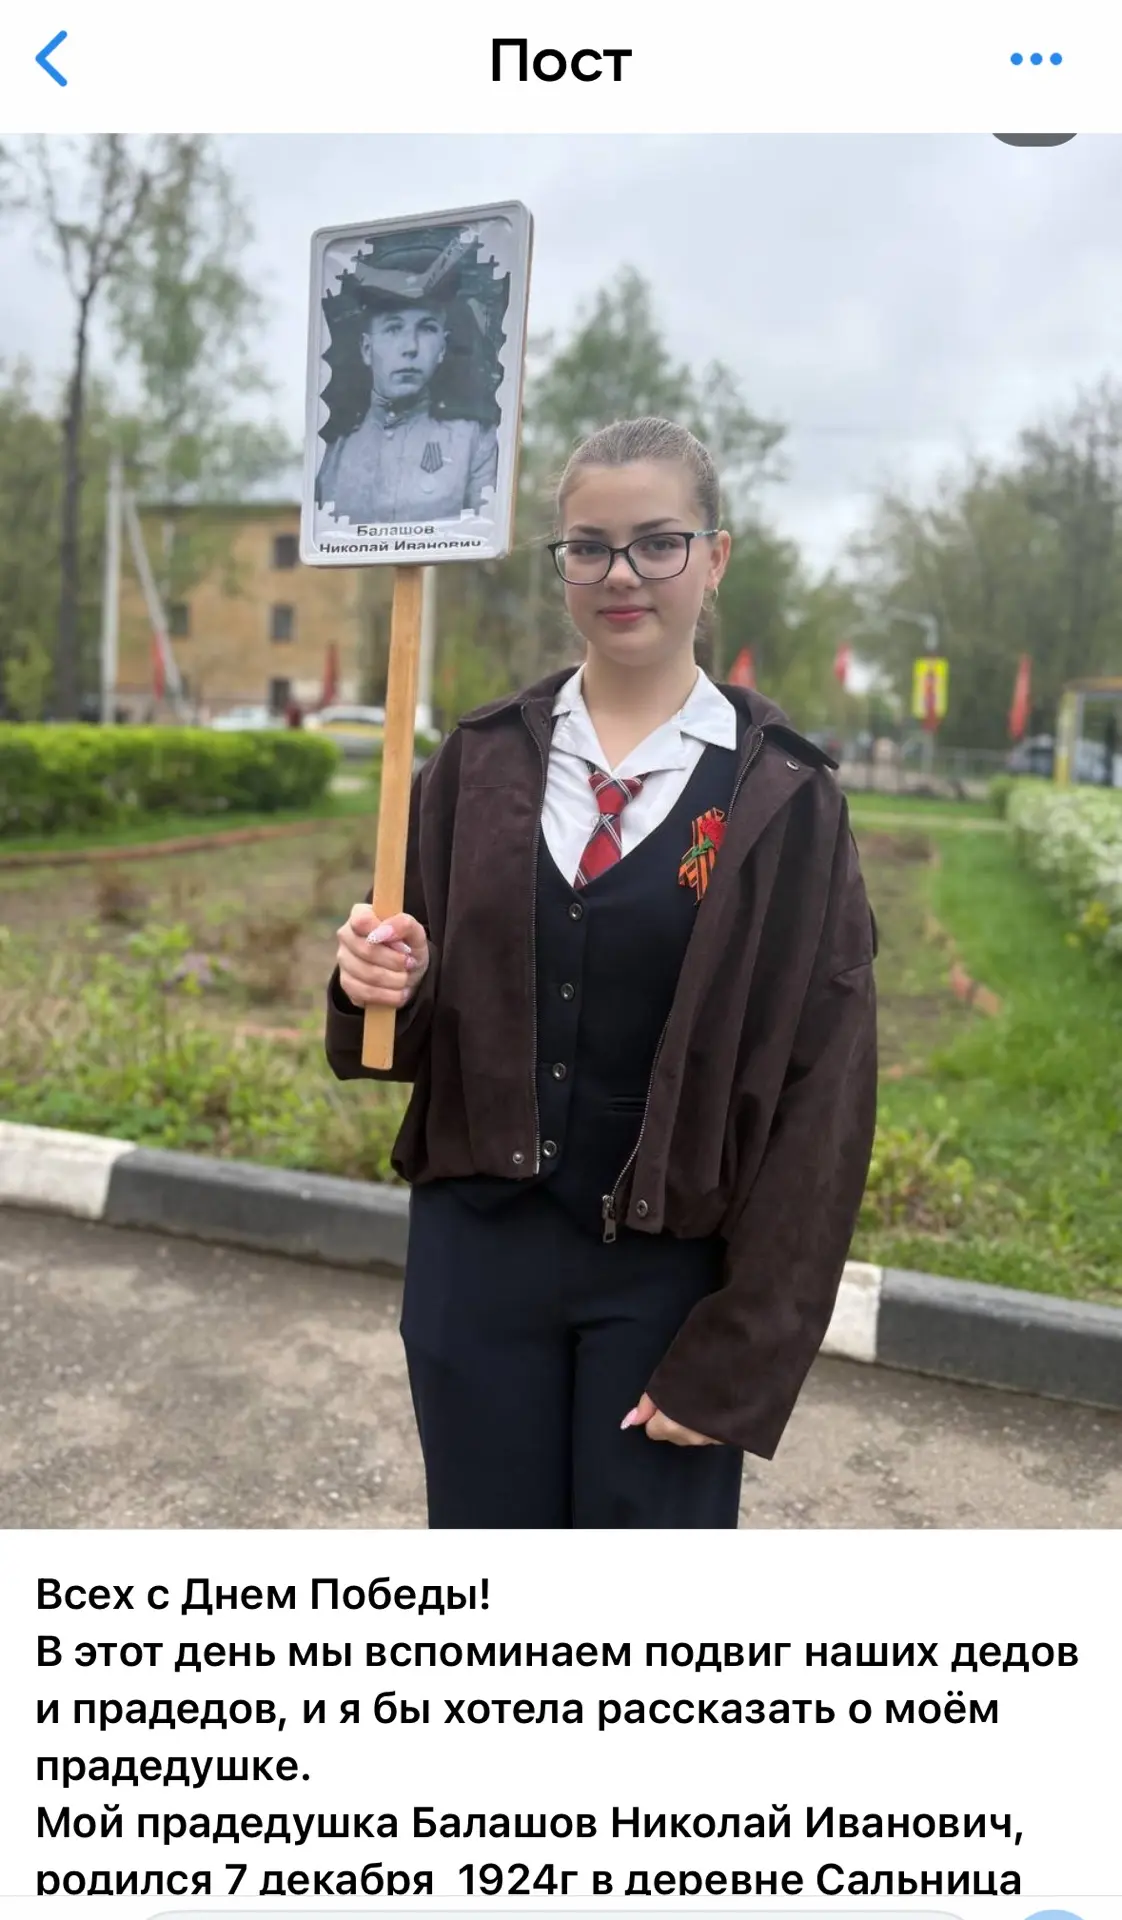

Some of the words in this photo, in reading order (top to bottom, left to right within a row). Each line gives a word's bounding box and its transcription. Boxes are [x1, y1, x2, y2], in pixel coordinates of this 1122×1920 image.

[492, 38, 633, 83] Пост
[319, 541, 389, 553] Николай
[356, 525, 435, 537] Балашов
[37, 1577, 135, 1610] Всех
[147, 1585, 169, 1610] с
[181, 1577, 296, 1616] Днем
[311, 1576, 489, 1616] Победы!
[37, 1635, 62, 1667] В
[74, 1642, 164, 1667] этот
[174, 1642, 276, 1673] день
[289, 1642, 352, 1667] мы
[366, 1642, 631, 1667] вспоминаем
[646, 1642, 792, 1673] подвиг
[805, 1642, 939, 1667] наших
[951, 1642, 1079, 1673] дедов
[37, 1699, 59, 1724] и
[74, 1699, 287, 1732] прадедов,
[303, 1699, 326, 1724] и
[339, 1699, 360, 1724] я
[373, 1690, 430, 1724] бы
[443, 1699, 583, 1724] хотела
[598, 1699, 836, 1732] рассказать
[848, 1699, 872, 1724] о
[885, 1690, 998, 1725] моём
[37, 1756, 310, 1789] прадедушке.
[37, 1803, 123, 1839] Мой
[137, 1813, 398, 1846] прадедушка
[413, 1806, 597, 1839] Балашов
[612, 1803, 791, 1839] Николай
[806, 1806, 1023, 1846] Иванович,
[37, 1870, 211, 1896] родился
[225, 1863, 248, 1895] 7
[259, 1861, 433, 1896] декабря
[459, 1862, 579, 1896] 1924г
[592, 1870, 614, 1895] в
[624, 1870, 804, 1896] деревне
[816, 1862, 1021, 1896] Сальница
